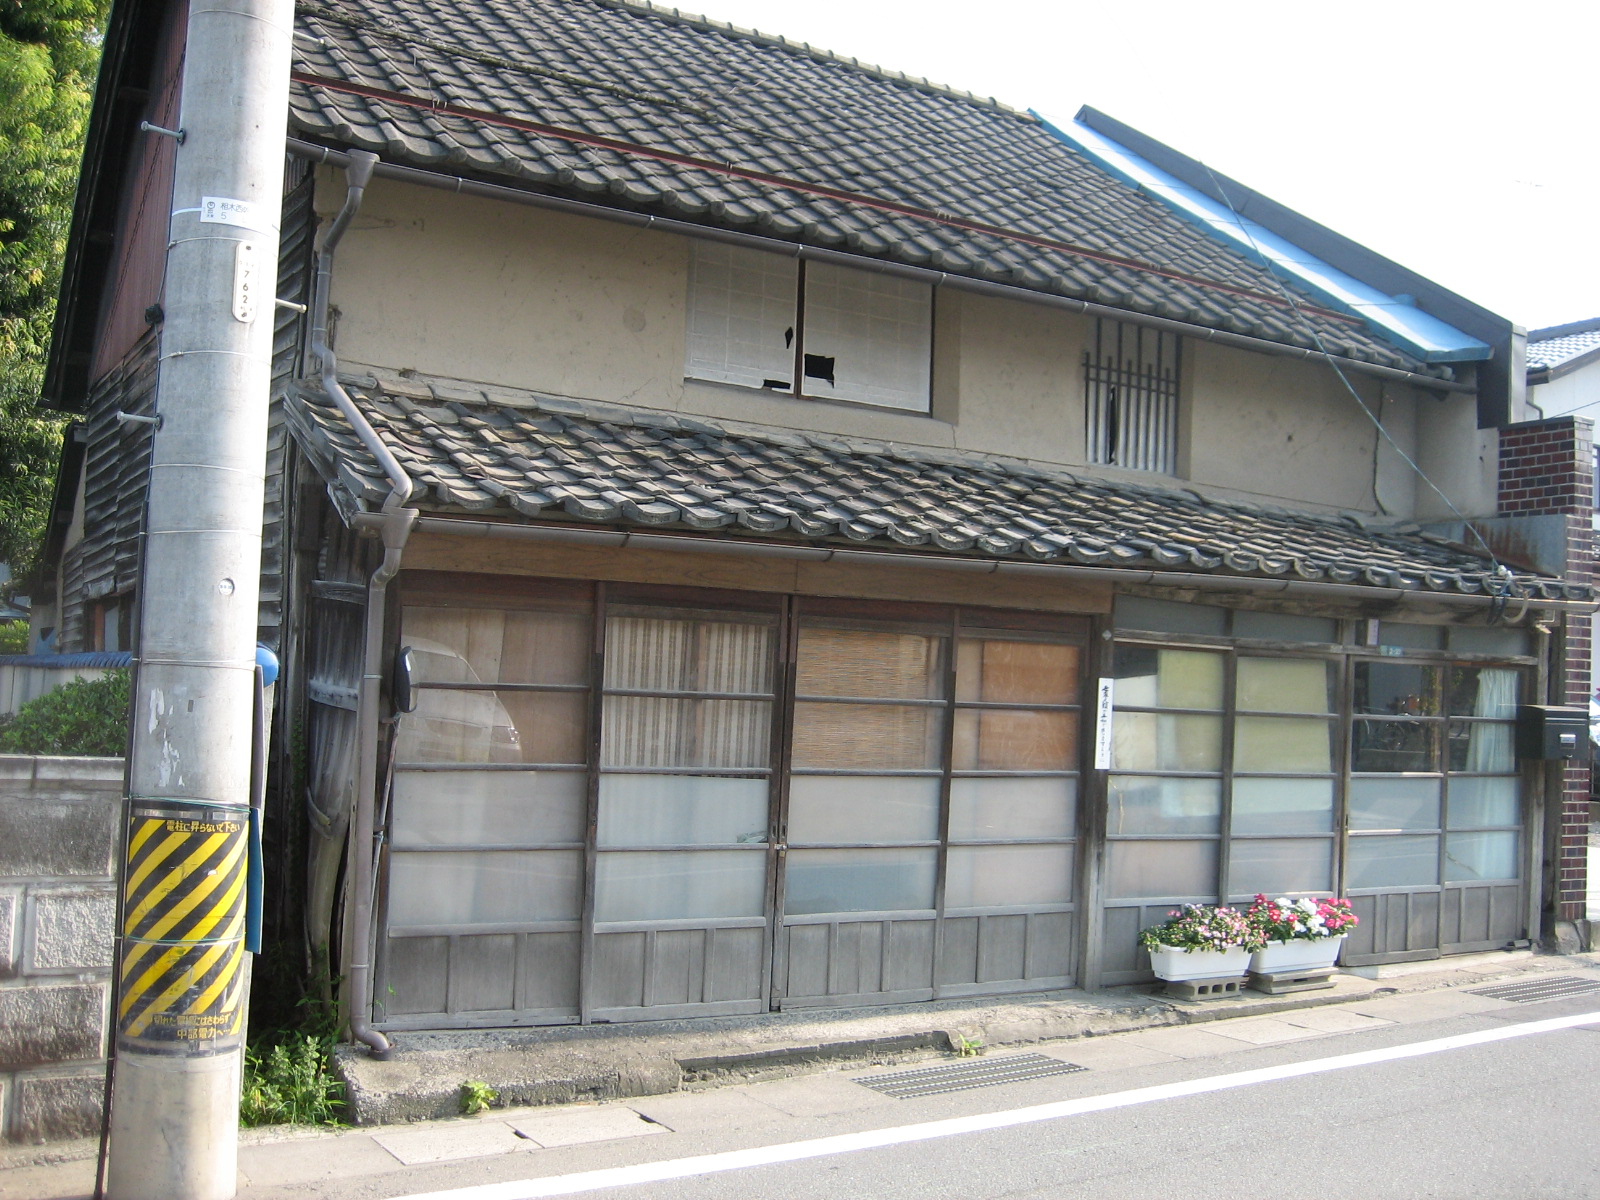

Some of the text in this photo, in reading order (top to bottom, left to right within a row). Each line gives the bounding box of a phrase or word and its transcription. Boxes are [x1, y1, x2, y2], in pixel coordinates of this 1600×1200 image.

[220, 211, 227, 220] 5
[166, 820, 241, 833] 電柱に昇らないで下さい
